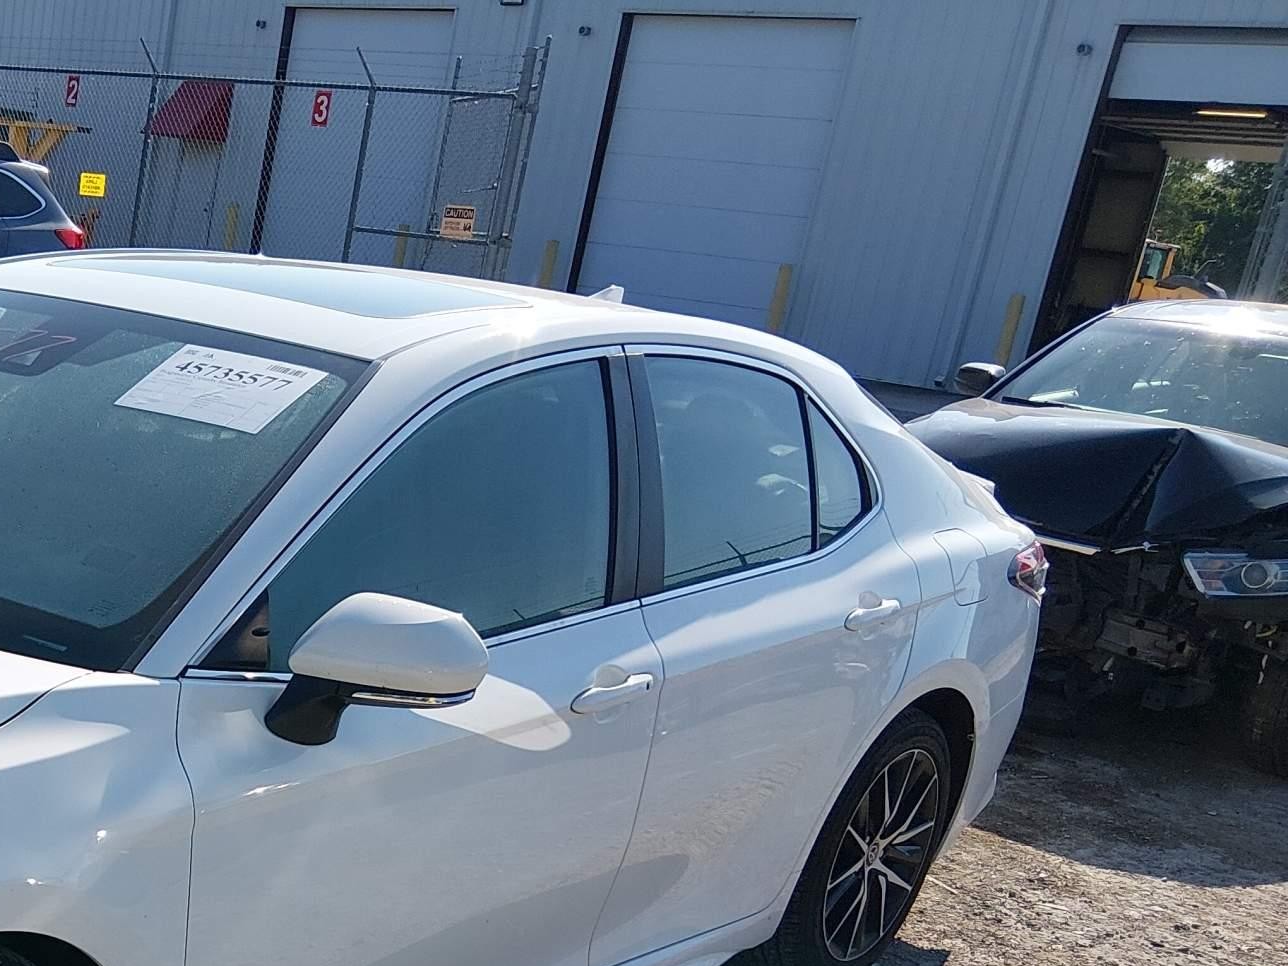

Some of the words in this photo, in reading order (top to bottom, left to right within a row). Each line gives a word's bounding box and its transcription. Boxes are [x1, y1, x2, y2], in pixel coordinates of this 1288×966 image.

[66, 80, 79, 105] 2
[314, 95, 329, 123] 3
[445, 208, 474, 219] CAUTION
[174, 359, 294, 392] 45735577
